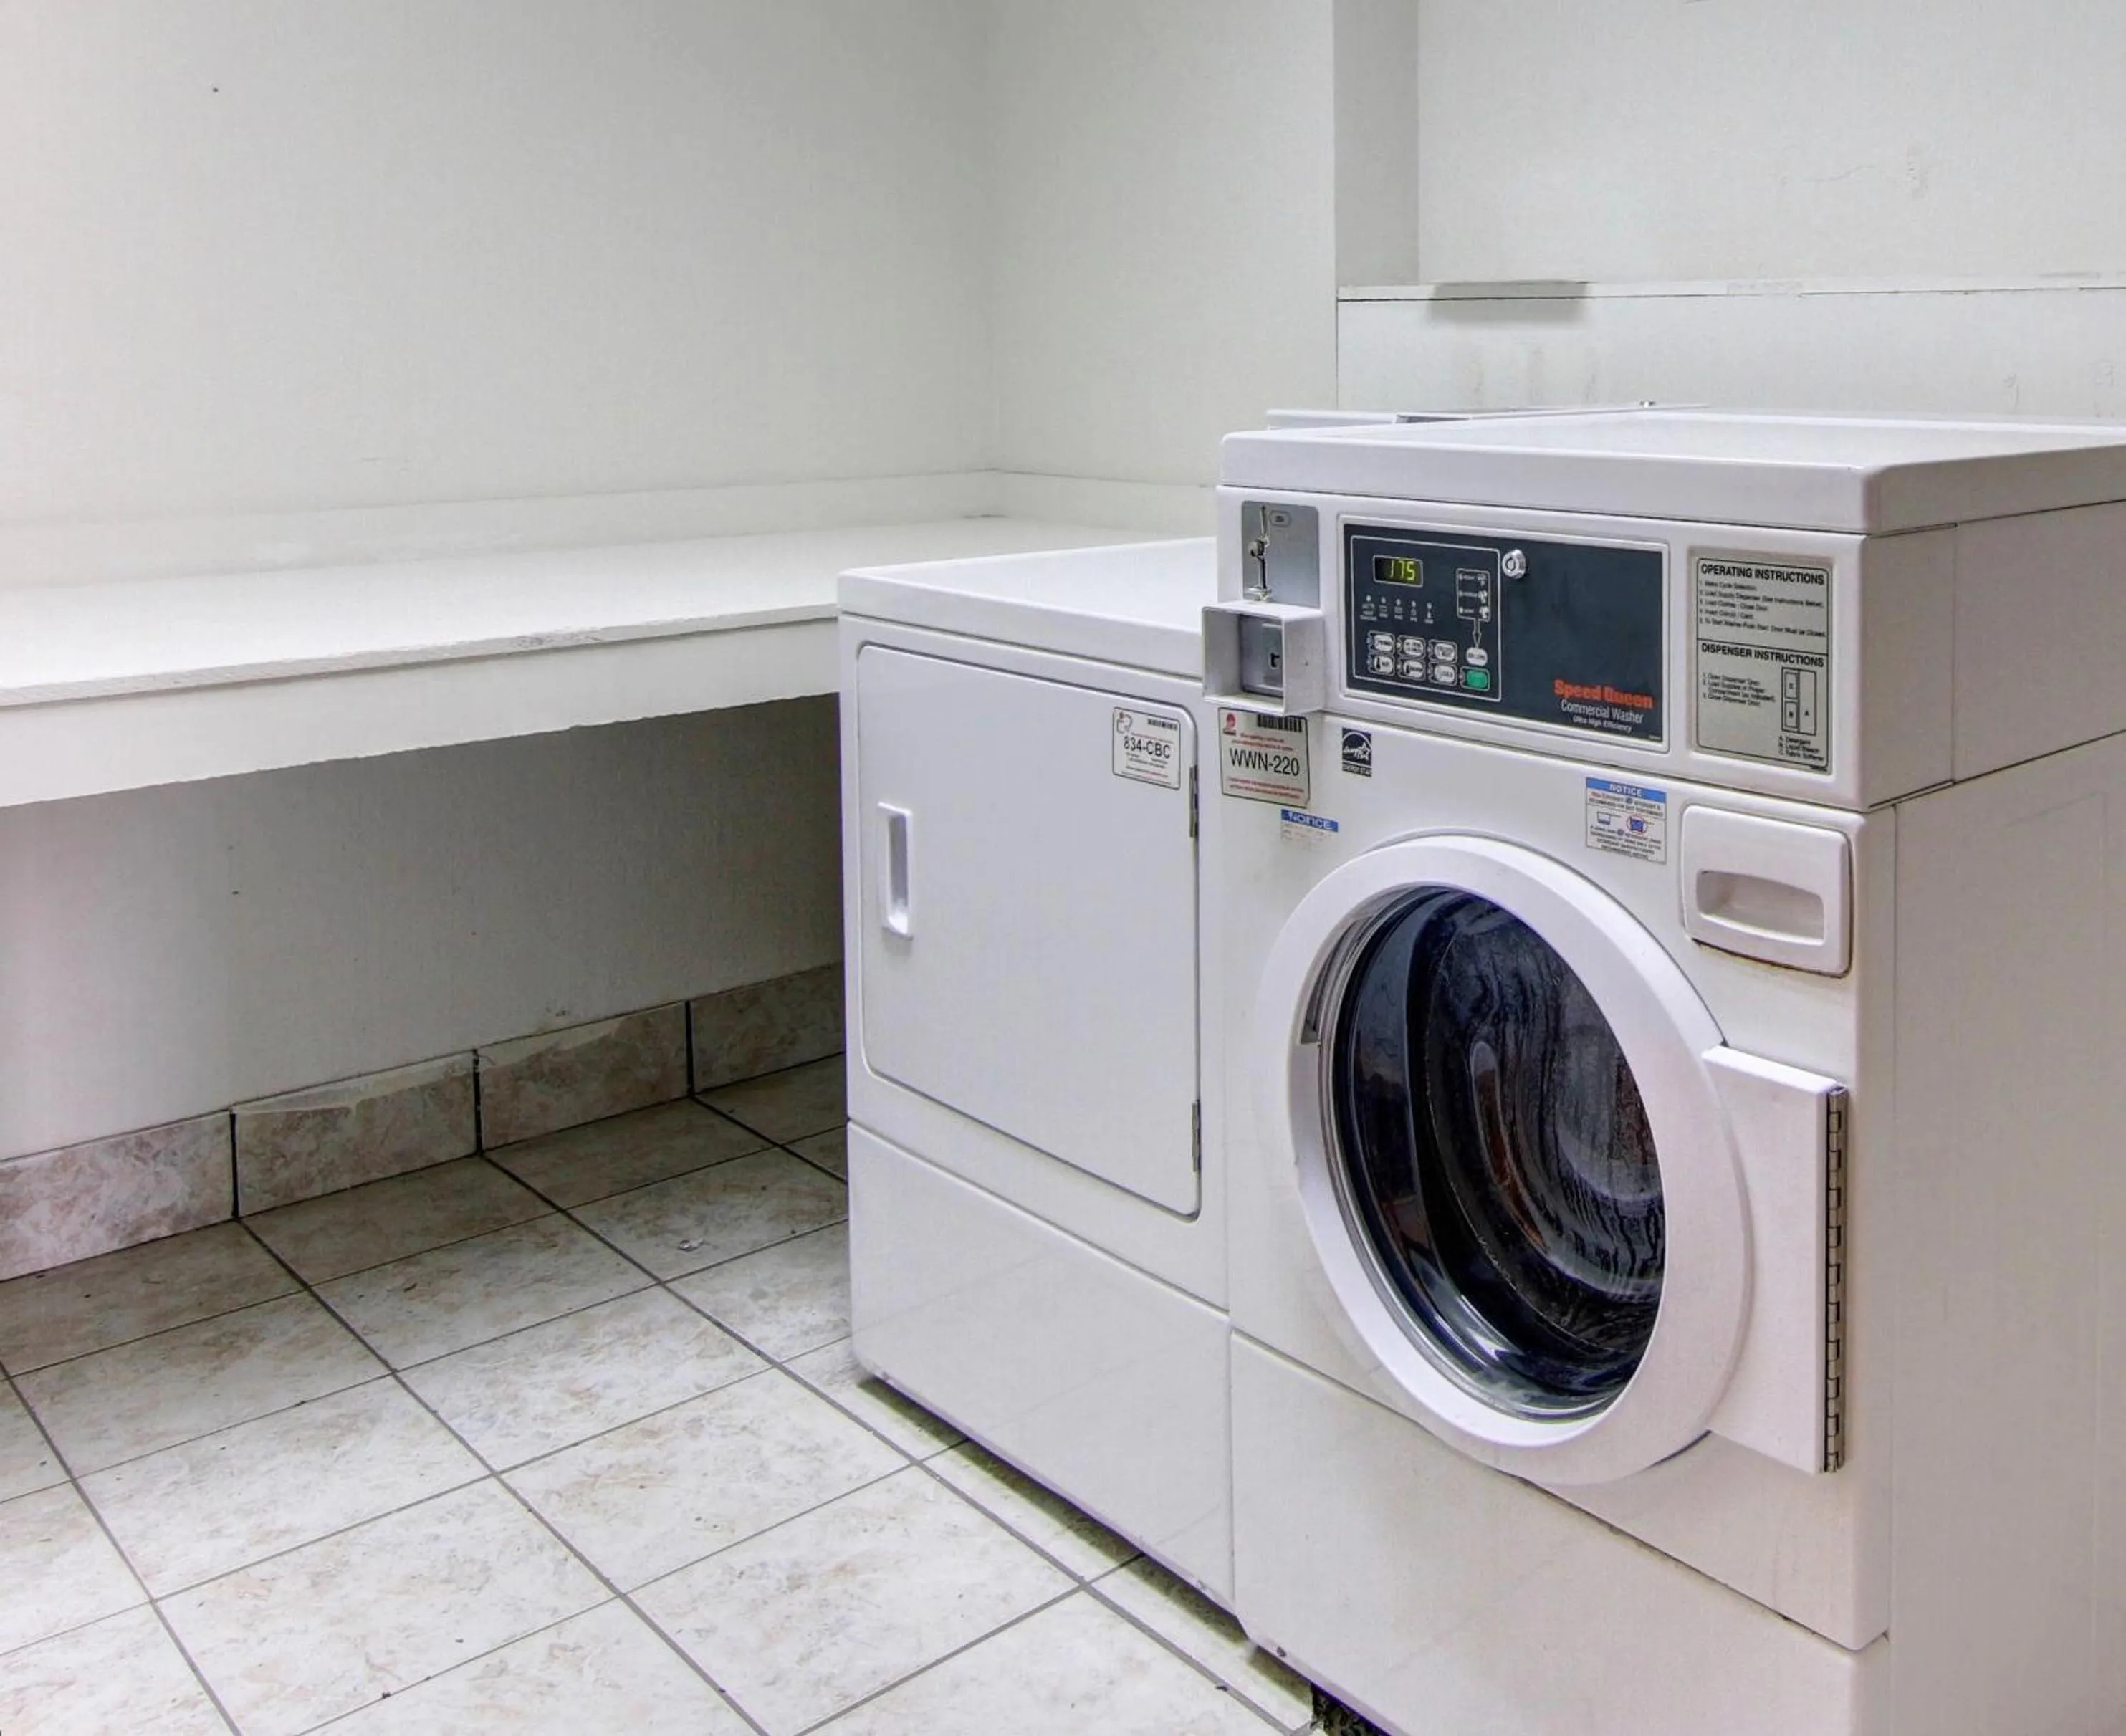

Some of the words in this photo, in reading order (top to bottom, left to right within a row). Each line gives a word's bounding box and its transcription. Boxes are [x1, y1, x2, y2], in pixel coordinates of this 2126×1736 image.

[1389, 559, 1416, 582] 175
[1701, 563, 1753, 579] OPERATING
[1754, 568, 1825, 586] INSTRUCTIONS
[1701, 643, 1753, 658] DISPENSER
[1753, 648, 1825, 668] INSTRUCTIONS
[1553, 678, 1601, 699] Speed
[1603, 685, 1654, 709] Queen
[1561, 698, 1610, 719] Commercial
[1612, 707, 1644, 724] Washer
[1123, 735, 1172, 759] 834-CBC
[1230, 747, 1301, 777] WWN-220
[1609, 783, 1643, 798] NOTICE
[1288, 810, 1333, 830] NOTICE
